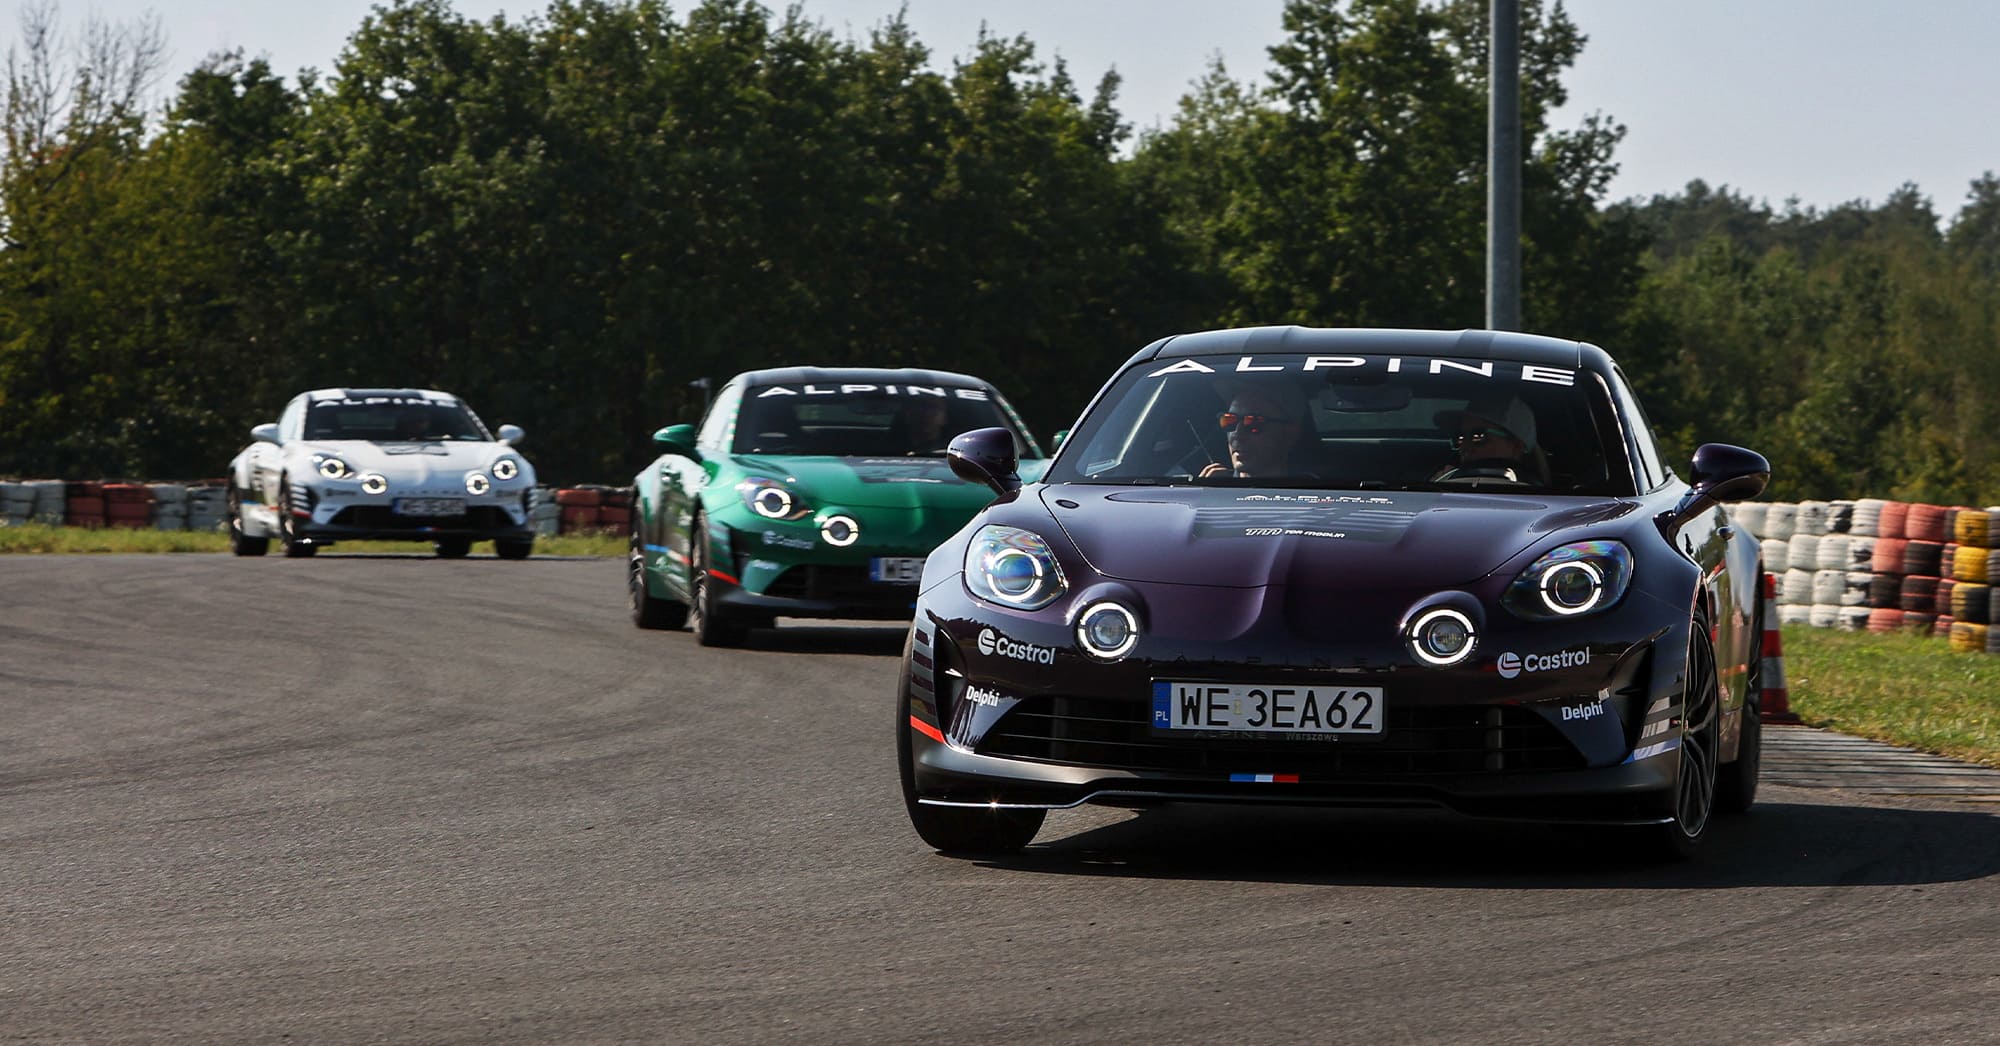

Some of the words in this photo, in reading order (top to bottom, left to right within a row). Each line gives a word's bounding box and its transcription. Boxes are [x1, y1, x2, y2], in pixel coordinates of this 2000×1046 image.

[1147, 356, 1576, 386] ALPINE
[758, 384, 989, 401] ALPINE
[995, 639, 1056, 666] Castrol
[1524, 646, 1590, 672] Castrol
[965, 684, 999, 708] Delphi
[1180, 687, 1229, 726] WE
[1247, 689, 1373, 729] 3EA62
[1155, 710, 1169, 721] PL
[1562, 701, 1604, 722] Delphi
